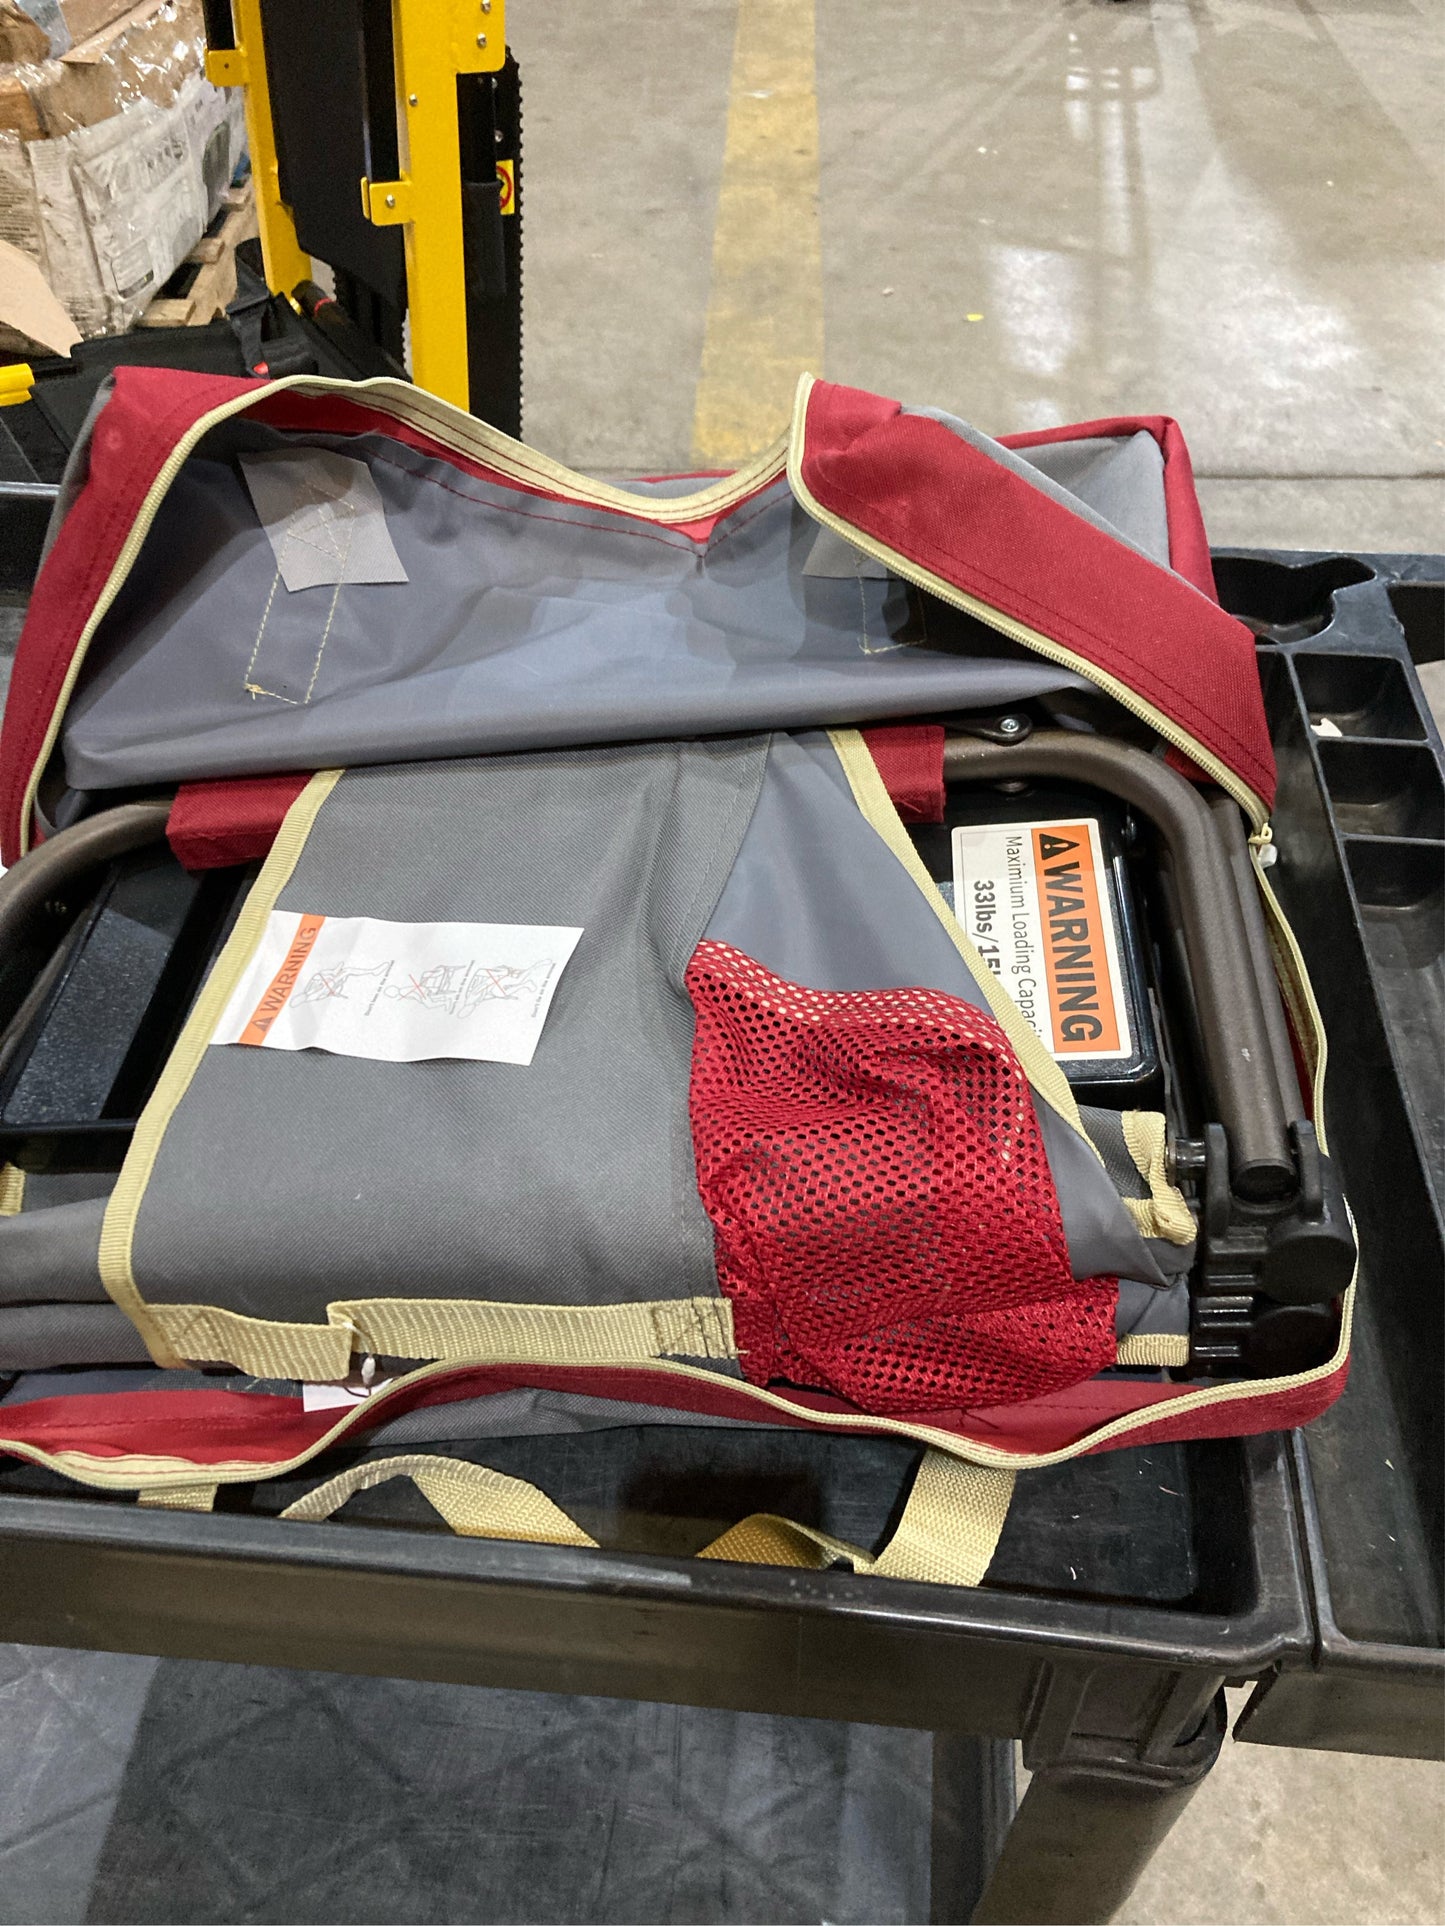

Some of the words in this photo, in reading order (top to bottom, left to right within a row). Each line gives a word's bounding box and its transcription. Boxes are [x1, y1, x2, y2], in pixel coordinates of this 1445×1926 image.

[1005, 836, 1028, 909] Maximium
[260, 927, 317, 1012] WARNING
[972, 879, 1001, 975] 33lbs/15
[1011, 912, 1035, 975] Loading
[1043, 861, 1103, 1042] WARNING
